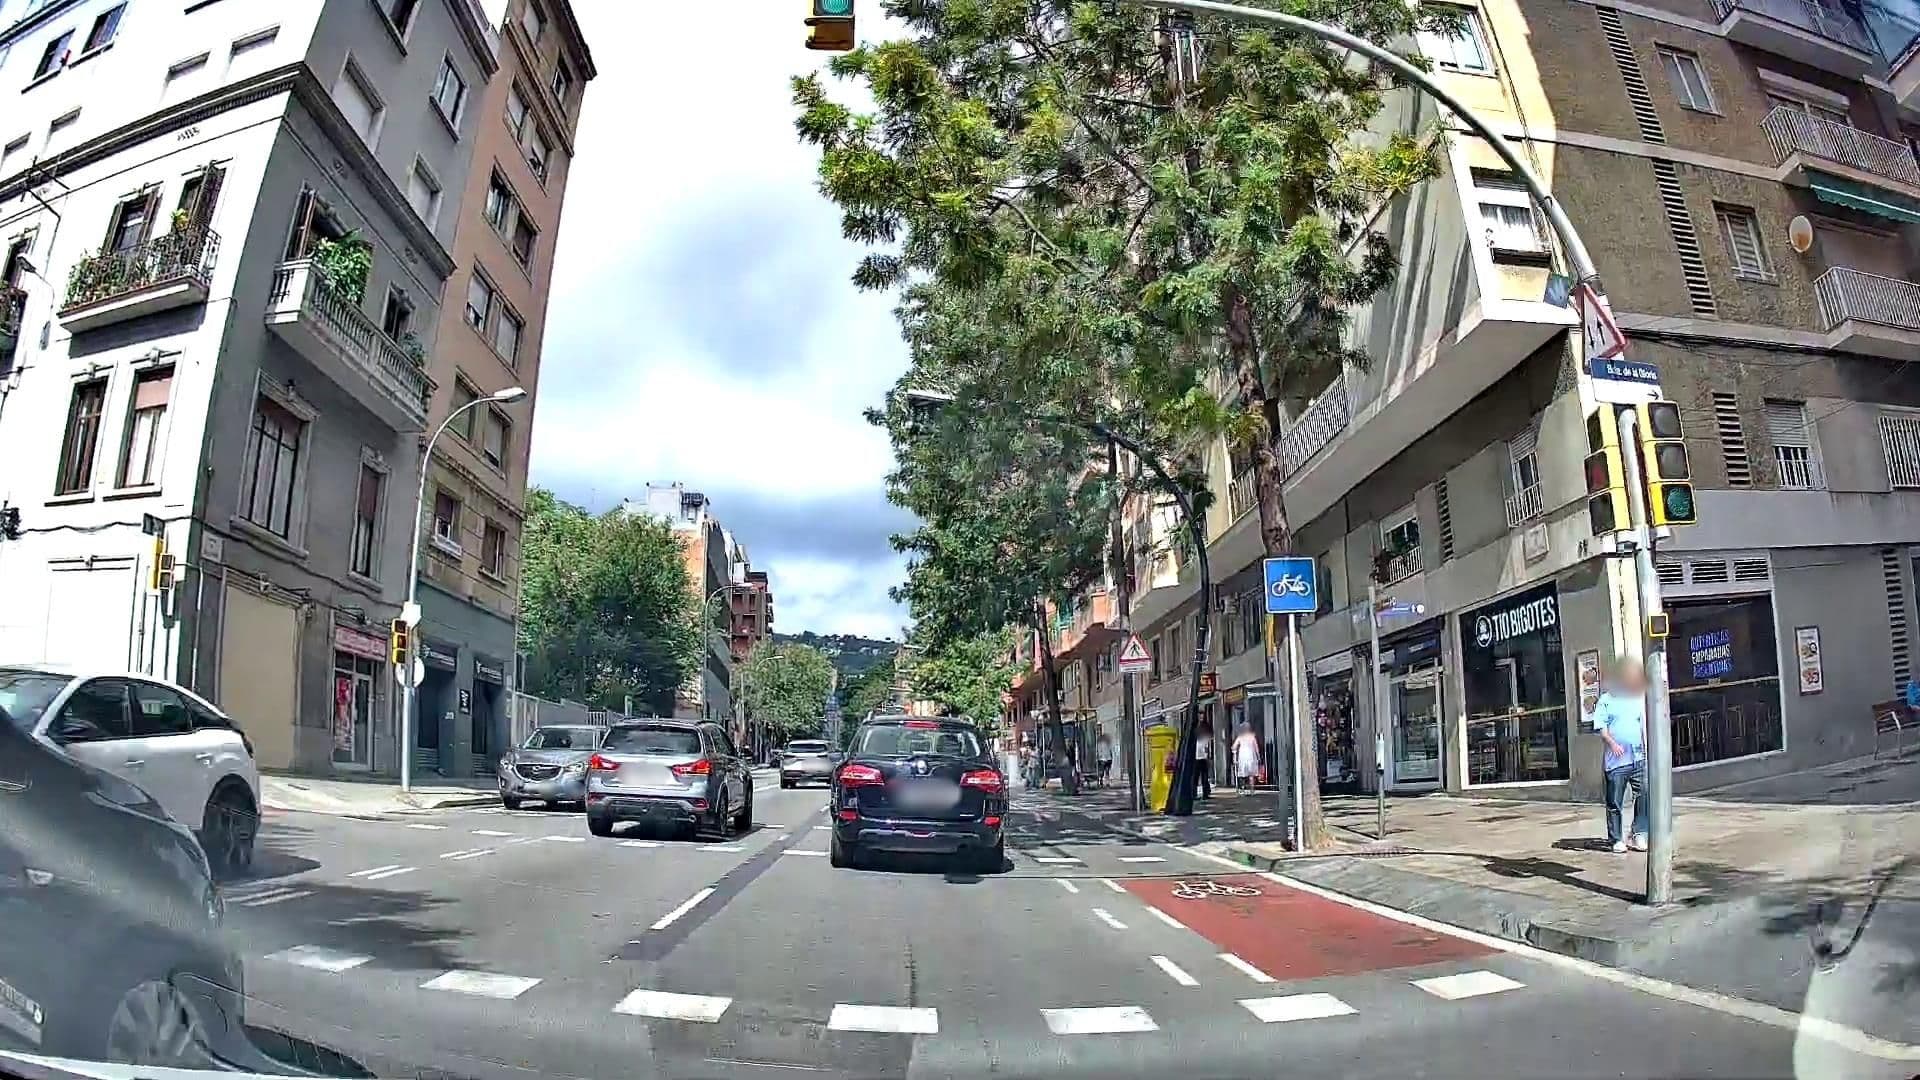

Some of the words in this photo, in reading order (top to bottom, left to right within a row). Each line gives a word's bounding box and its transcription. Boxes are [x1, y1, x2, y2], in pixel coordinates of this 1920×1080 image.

[1492, 612, 1510, 641] TIO
[1509, 595, 1556, 637] BIGOTES
[1691, 643, 1731, 665] EMPANADAS
